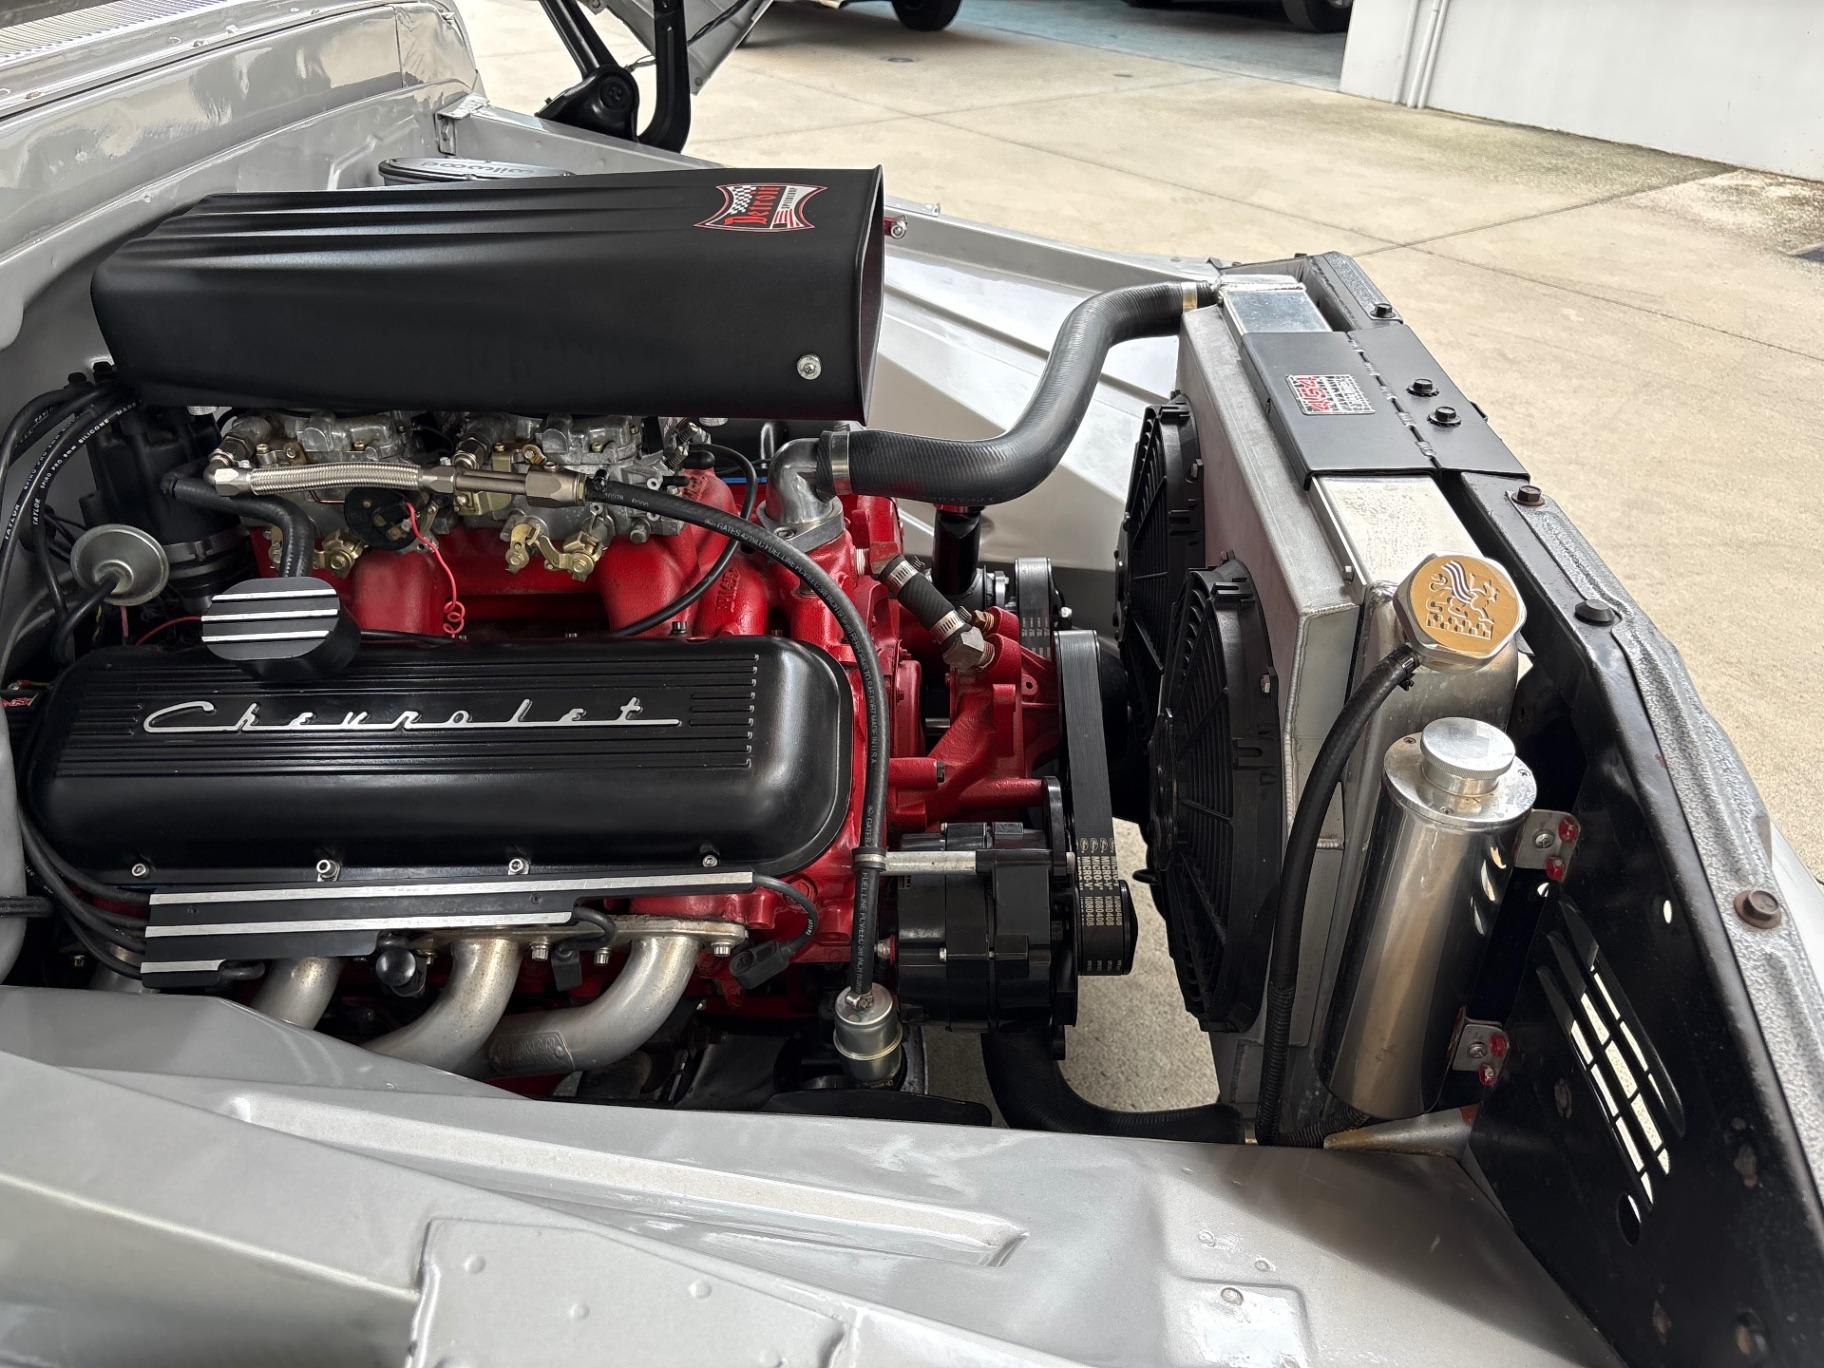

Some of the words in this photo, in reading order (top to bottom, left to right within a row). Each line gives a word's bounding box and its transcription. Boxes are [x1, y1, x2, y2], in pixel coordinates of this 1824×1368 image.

[724, 186, 780, 225] Detroit
[33, 498, 41, 525] TAYLOR
[78, 418, 110, 443] SILICONE
[717, 521, 741, 537] GATES
[143, 698, 681, 733] Chevrolet
